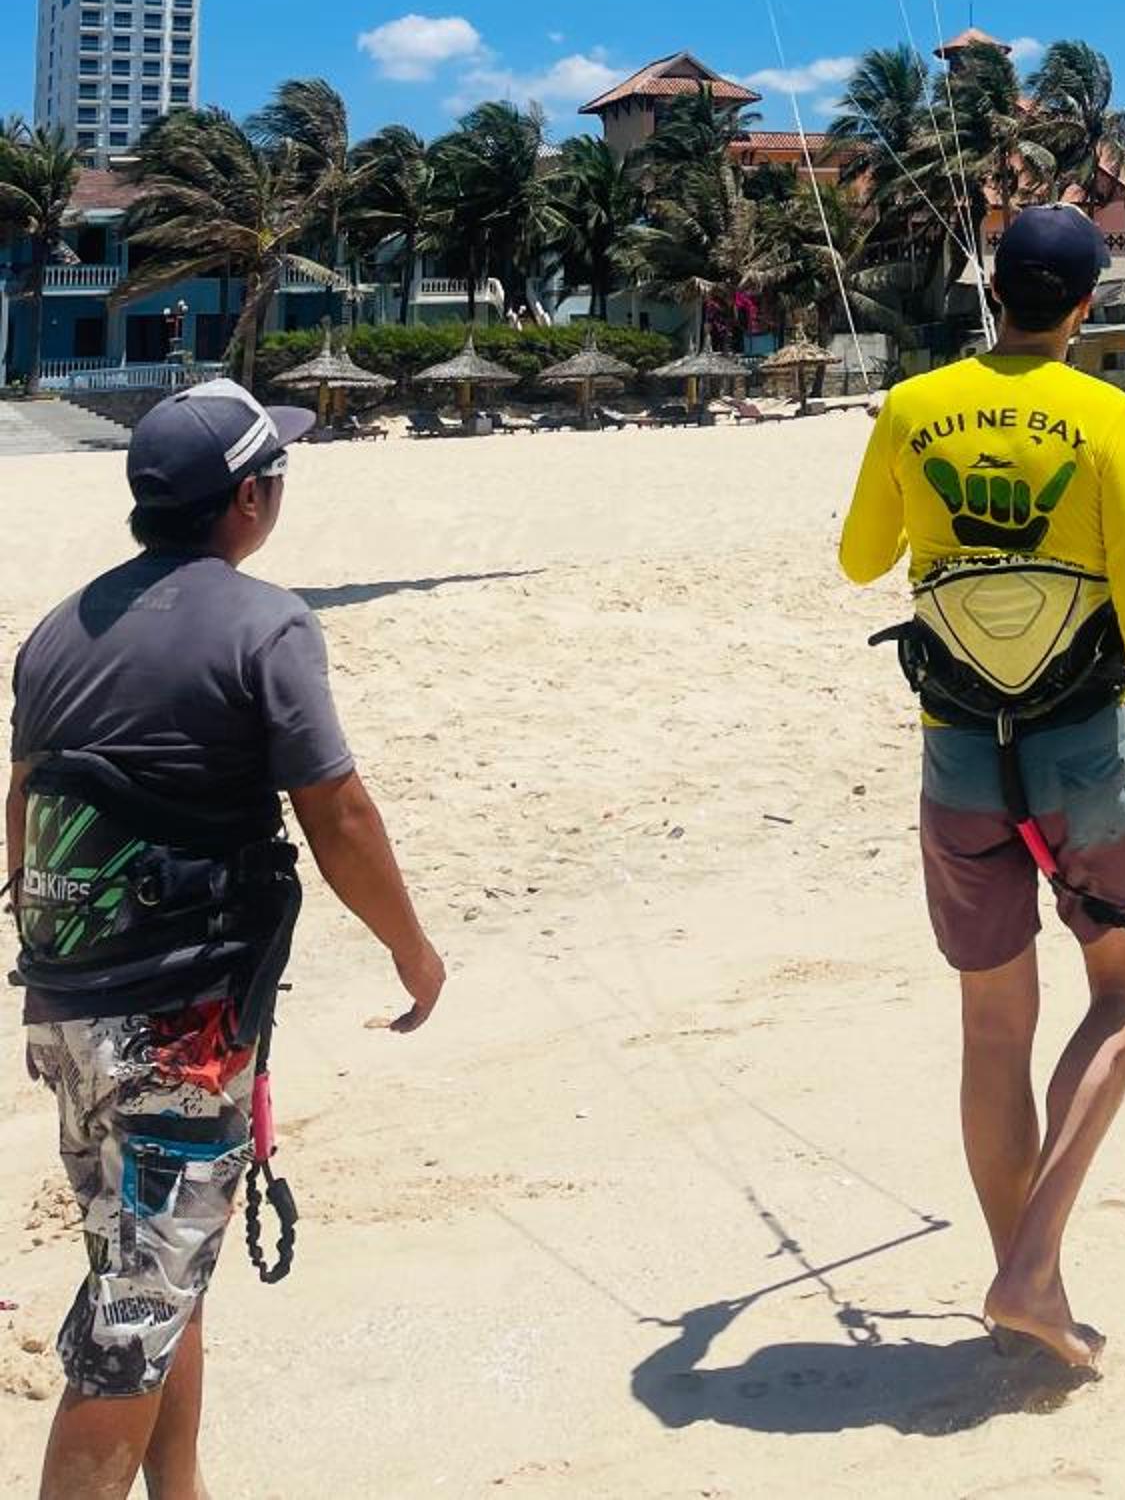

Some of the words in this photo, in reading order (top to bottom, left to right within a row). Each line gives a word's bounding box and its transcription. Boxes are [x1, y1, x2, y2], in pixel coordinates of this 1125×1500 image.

[910, 413, 966, 455] MUI
[977, 408, 1018, 429] NE
[1027, 410, 1087, 449] BAY
